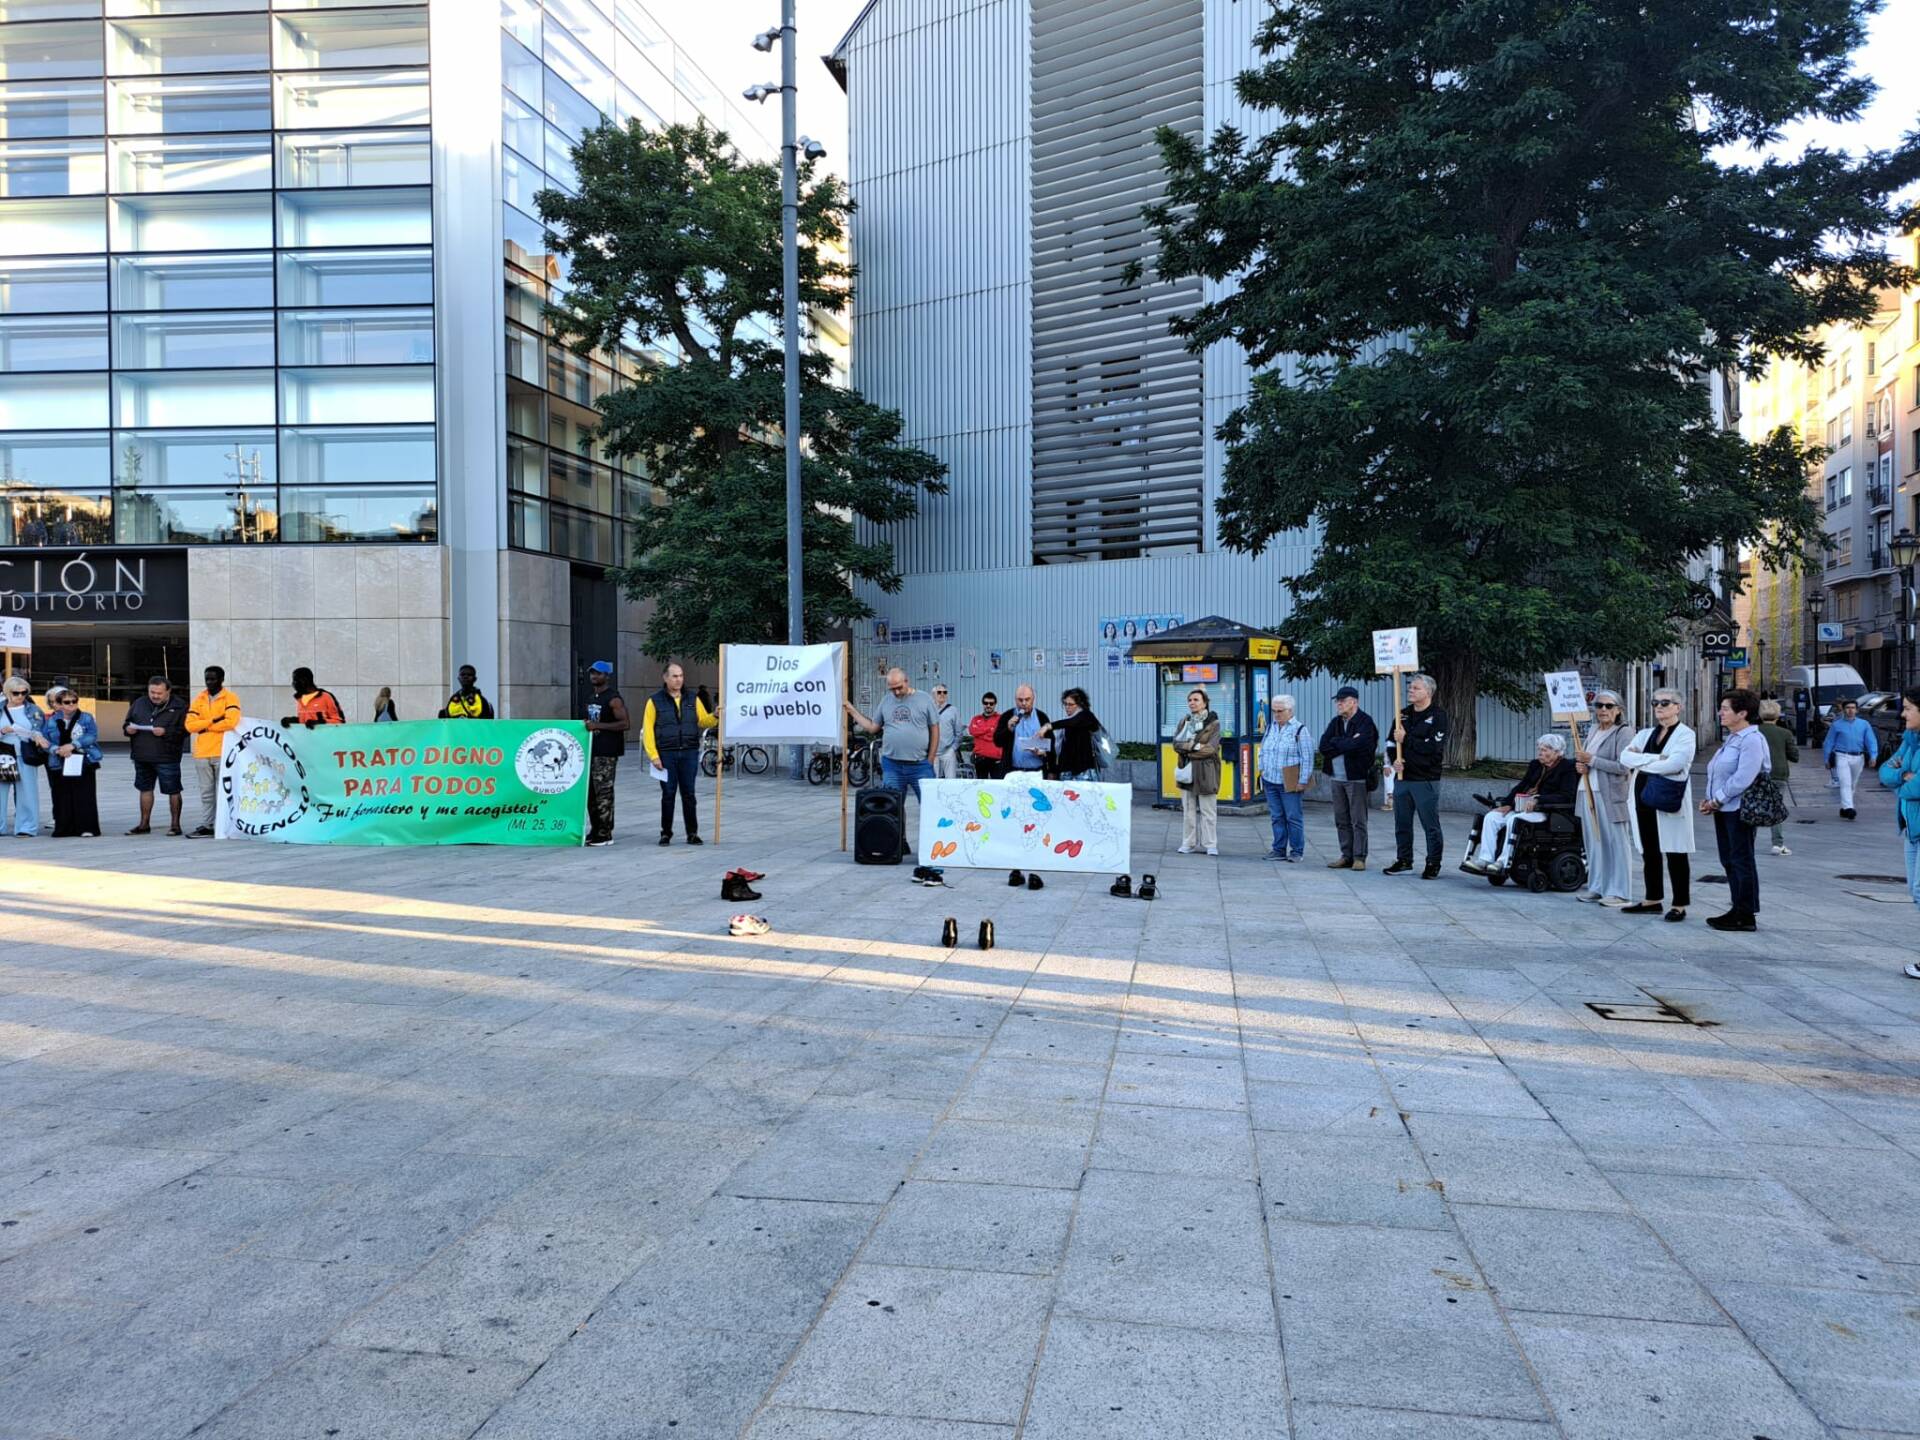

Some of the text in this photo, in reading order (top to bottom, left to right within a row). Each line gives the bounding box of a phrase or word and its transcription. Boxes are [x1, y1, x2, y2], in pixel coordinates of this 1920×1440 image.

[0, 593, 143, 611] DITORIO
[766, 655, 799, 671] Dios
[736, 678, 826, 694] camina con
[740, 700, 822, 720] su pueblo
[333, 746, 503, 768] TRATO DIGNO
[344, 775, 496, 797] PARA TODOS
[235, 785, 310, 836] SILENCIO
[351, 803, 414, 820] forastero
[420, 805, 430, 820] y
[436, 804, 459, 815] me
